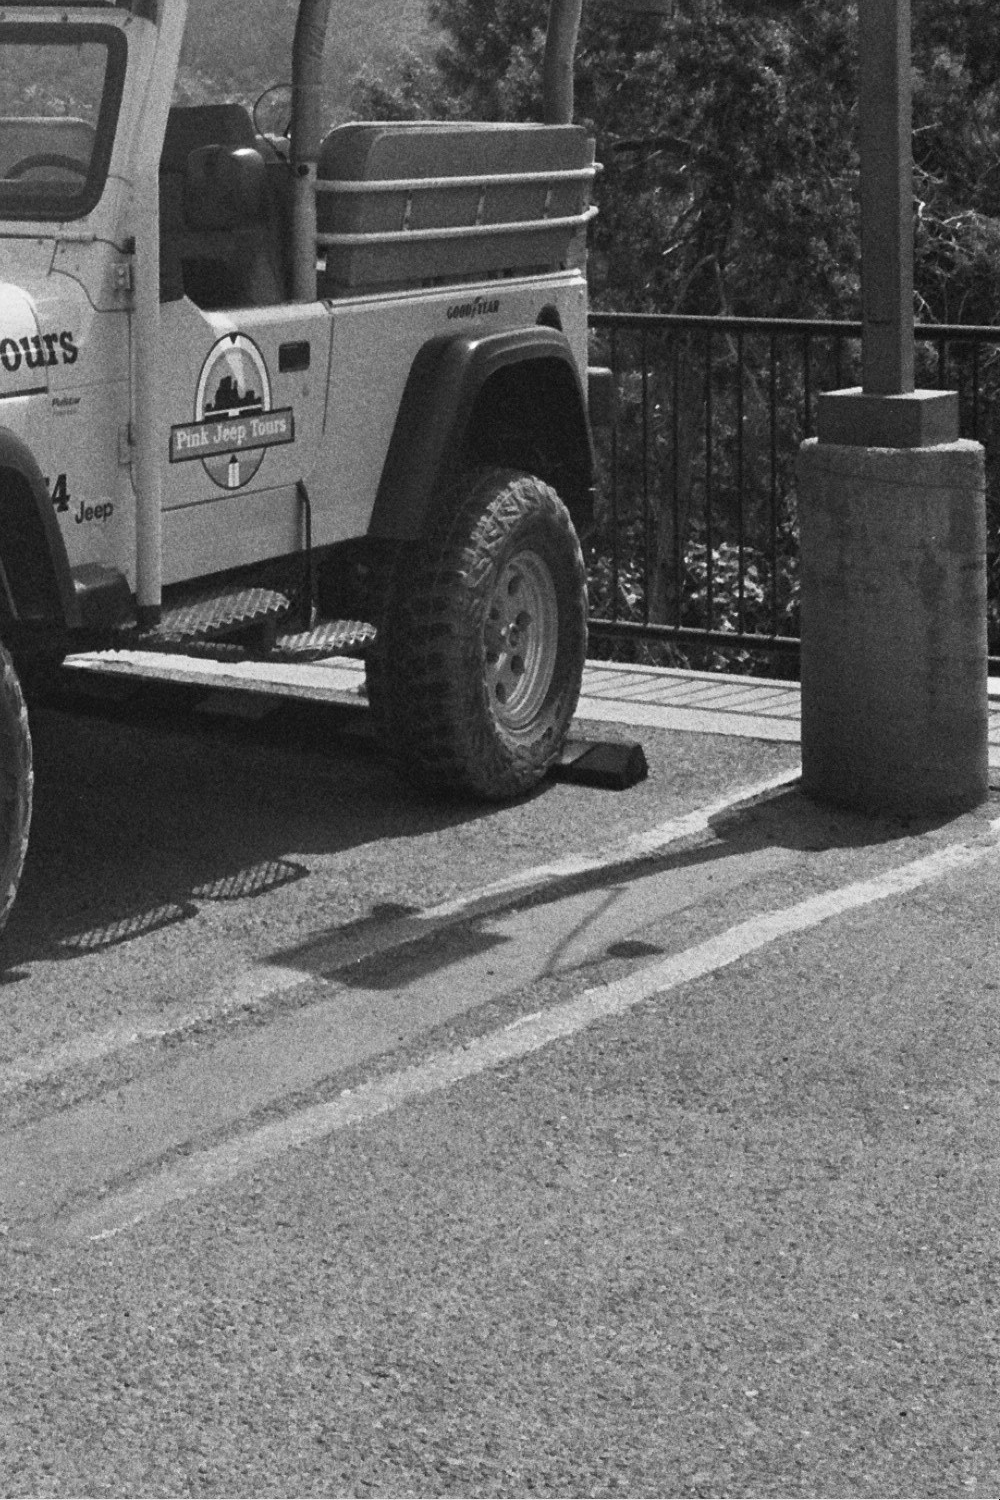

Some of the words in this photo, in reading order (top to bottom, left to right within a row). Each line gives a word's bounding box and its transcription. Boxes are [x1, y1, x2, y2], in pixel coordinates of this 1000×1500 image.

[446, 296, 500, 319] GOODYEAR
[176, 429, 210, 450] Pink
[213, 424, 247, 446] Jeep
[250, 418, 287, 437] Tours
[75, 501, 114, 524] Jeep
